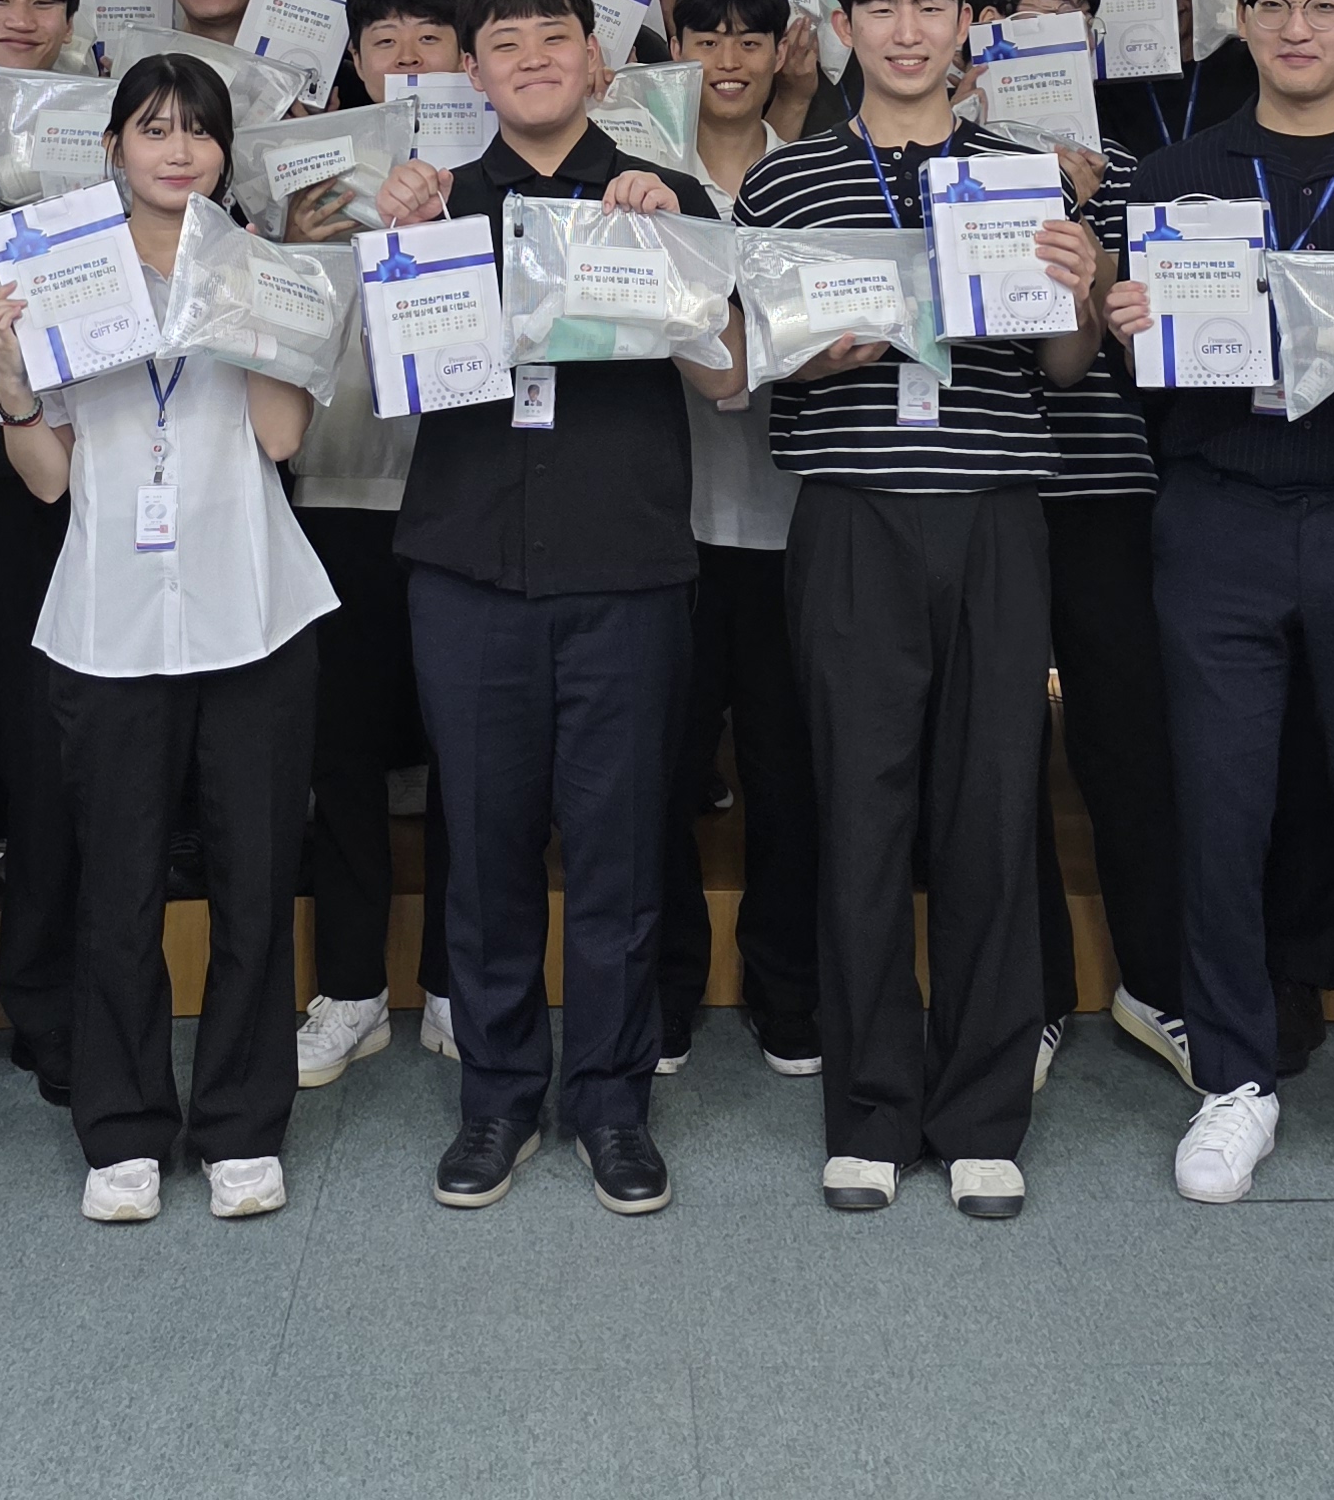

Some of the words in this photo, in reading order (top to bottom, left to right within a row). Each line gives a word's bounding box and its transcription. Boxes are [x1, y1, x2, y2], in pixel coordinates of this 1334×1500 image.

[1009, 293, 1028, 302] GIFT
[1030, 291, 1048, 300] SET
[90, 323, 112, 339] GIFT
[114, 319, 129, 331] SET
[1202, 345, 1224, 354] GIFT
[1226, 344, 1242, 353] SET
[443, 364, 465, 375] GIFT
[466, 361, 483, 371] SET
